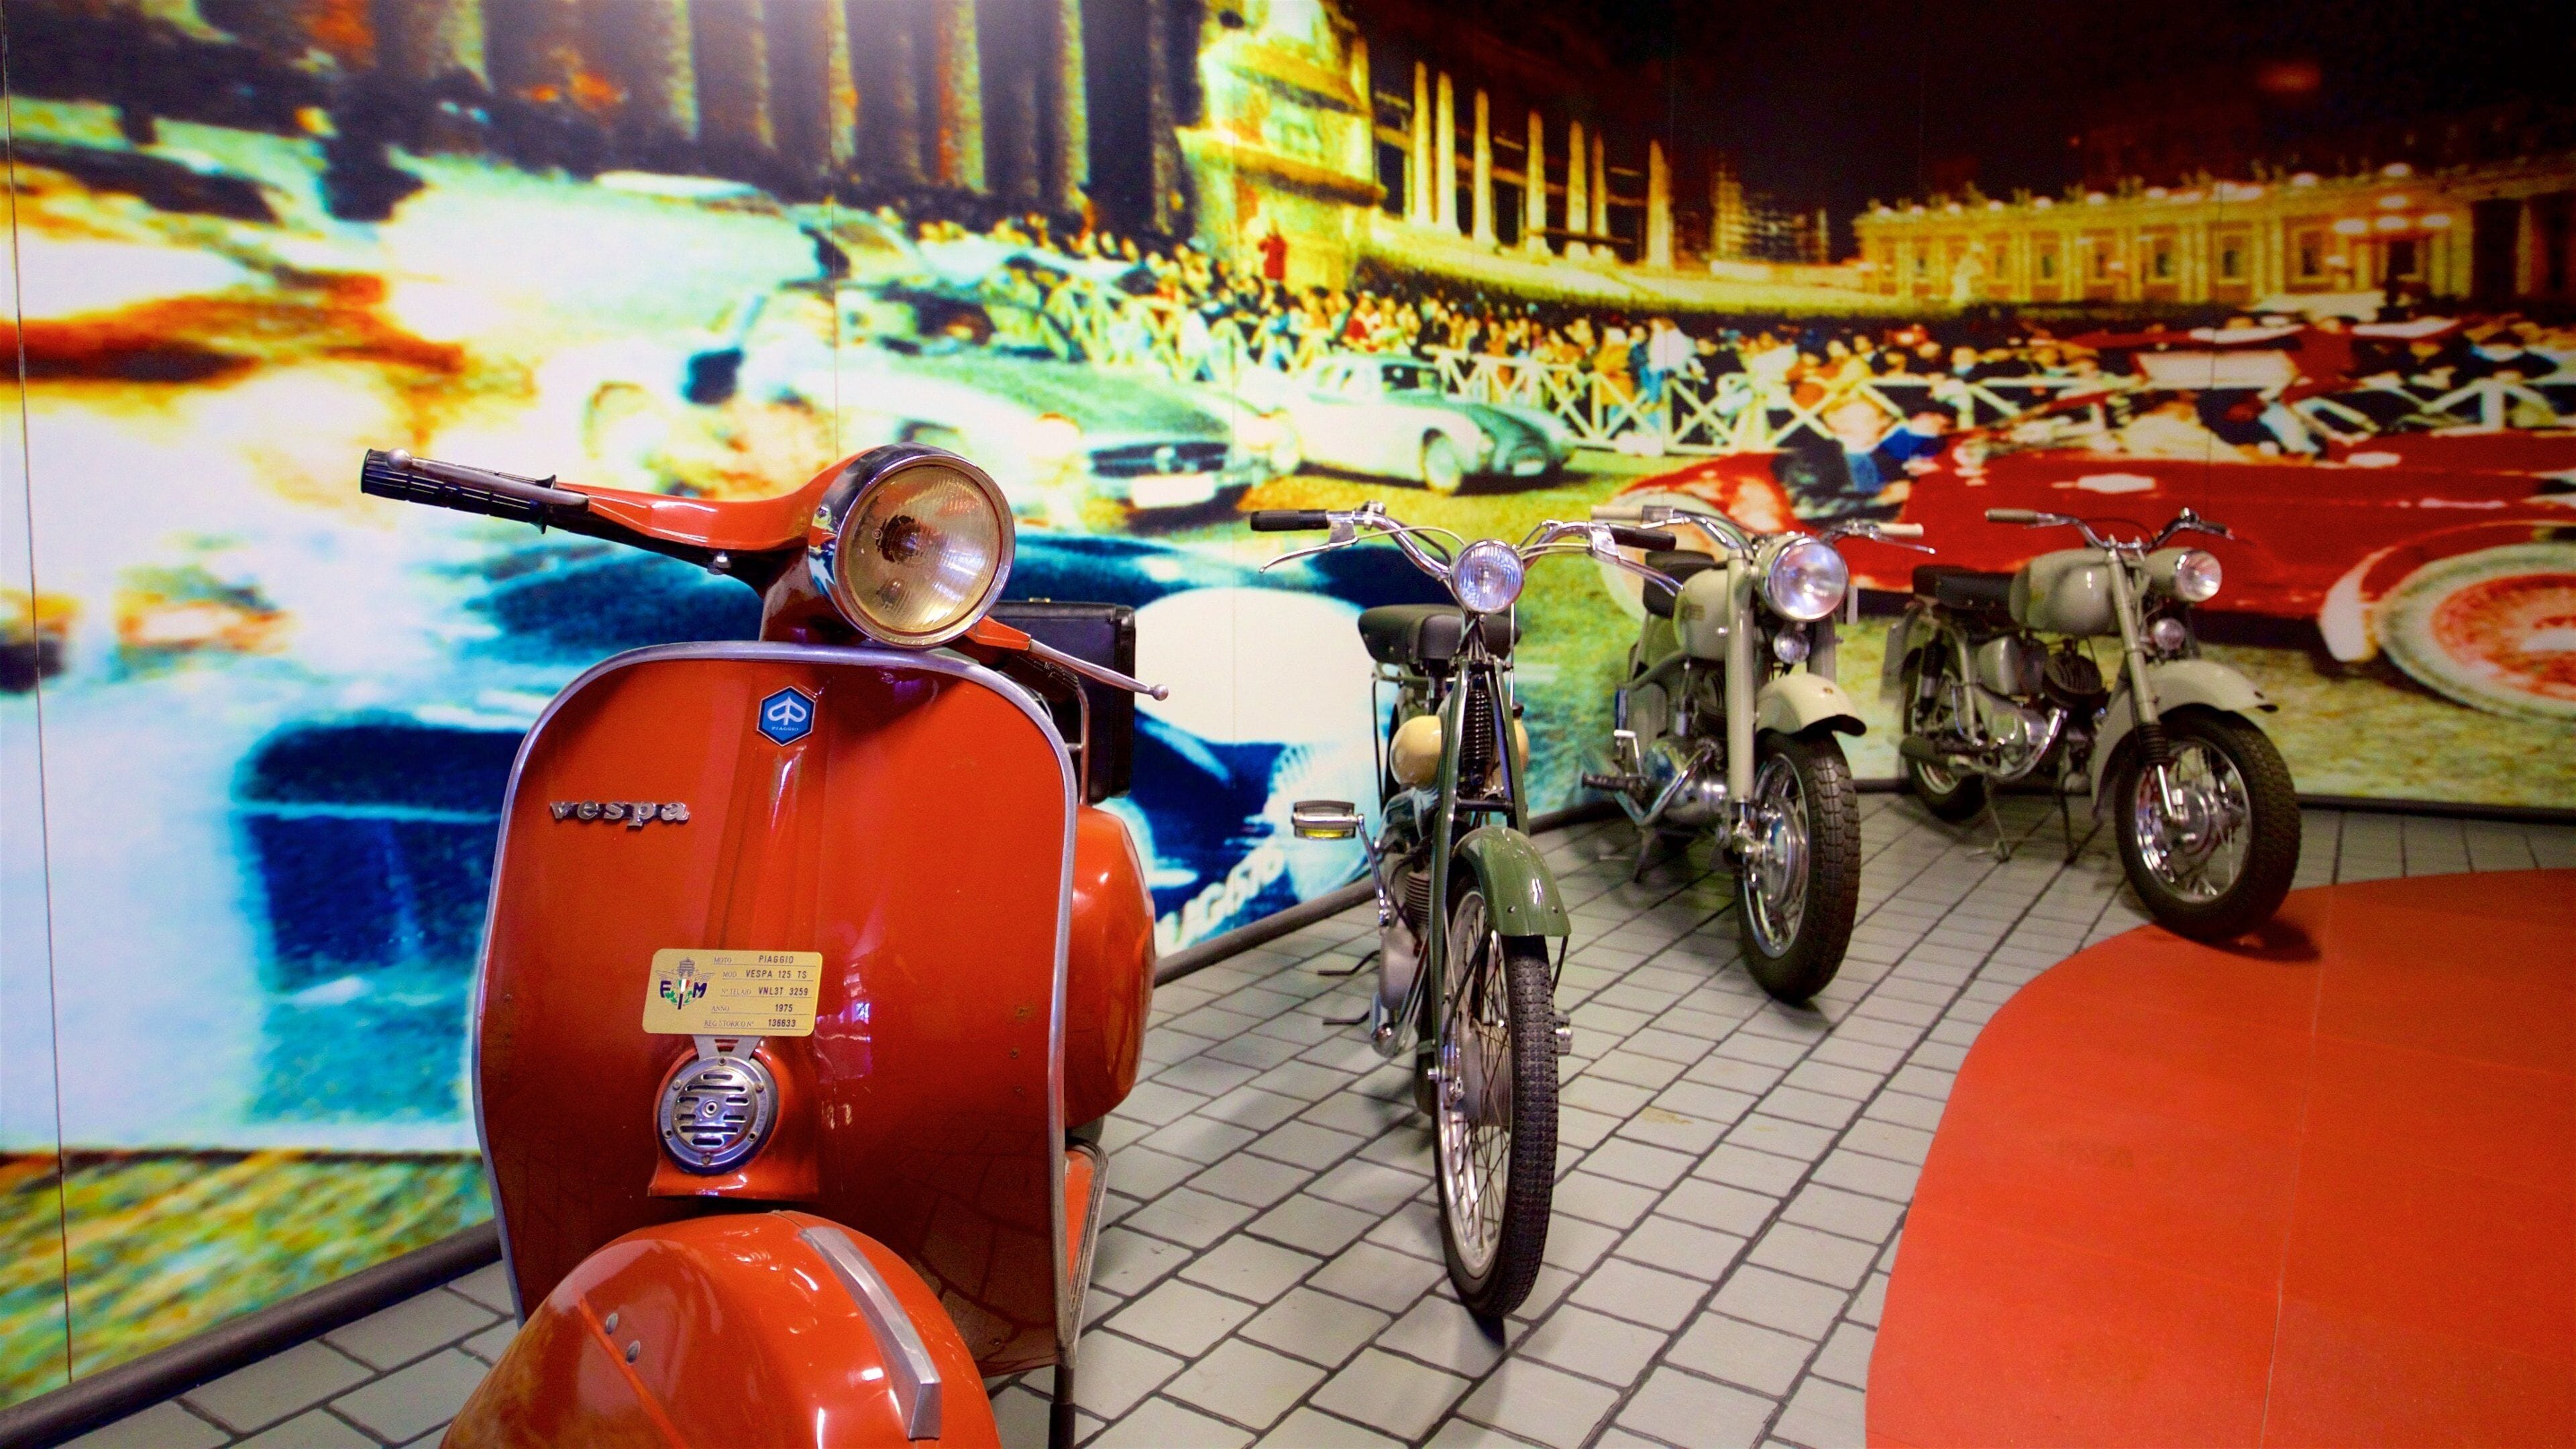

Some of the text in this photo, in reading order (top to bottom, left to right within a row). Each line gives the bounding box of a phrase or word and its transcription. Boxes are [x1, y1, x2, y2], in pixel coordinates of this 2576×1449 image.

[550, 800, 690, 828] vespa
[758, 955, 794, 963] PIAGGIO
[745, 969, 773, 978] VESPA
[778, 970, 792, 979] 125
[798, 971, 808, 979] TS
[758, 987, 784, 995] VNL3T
[789, 987, 808, 996] 3259
[775, 1004, 793, 1012] 1975
[768, 1018, 796, 1028] 136633
